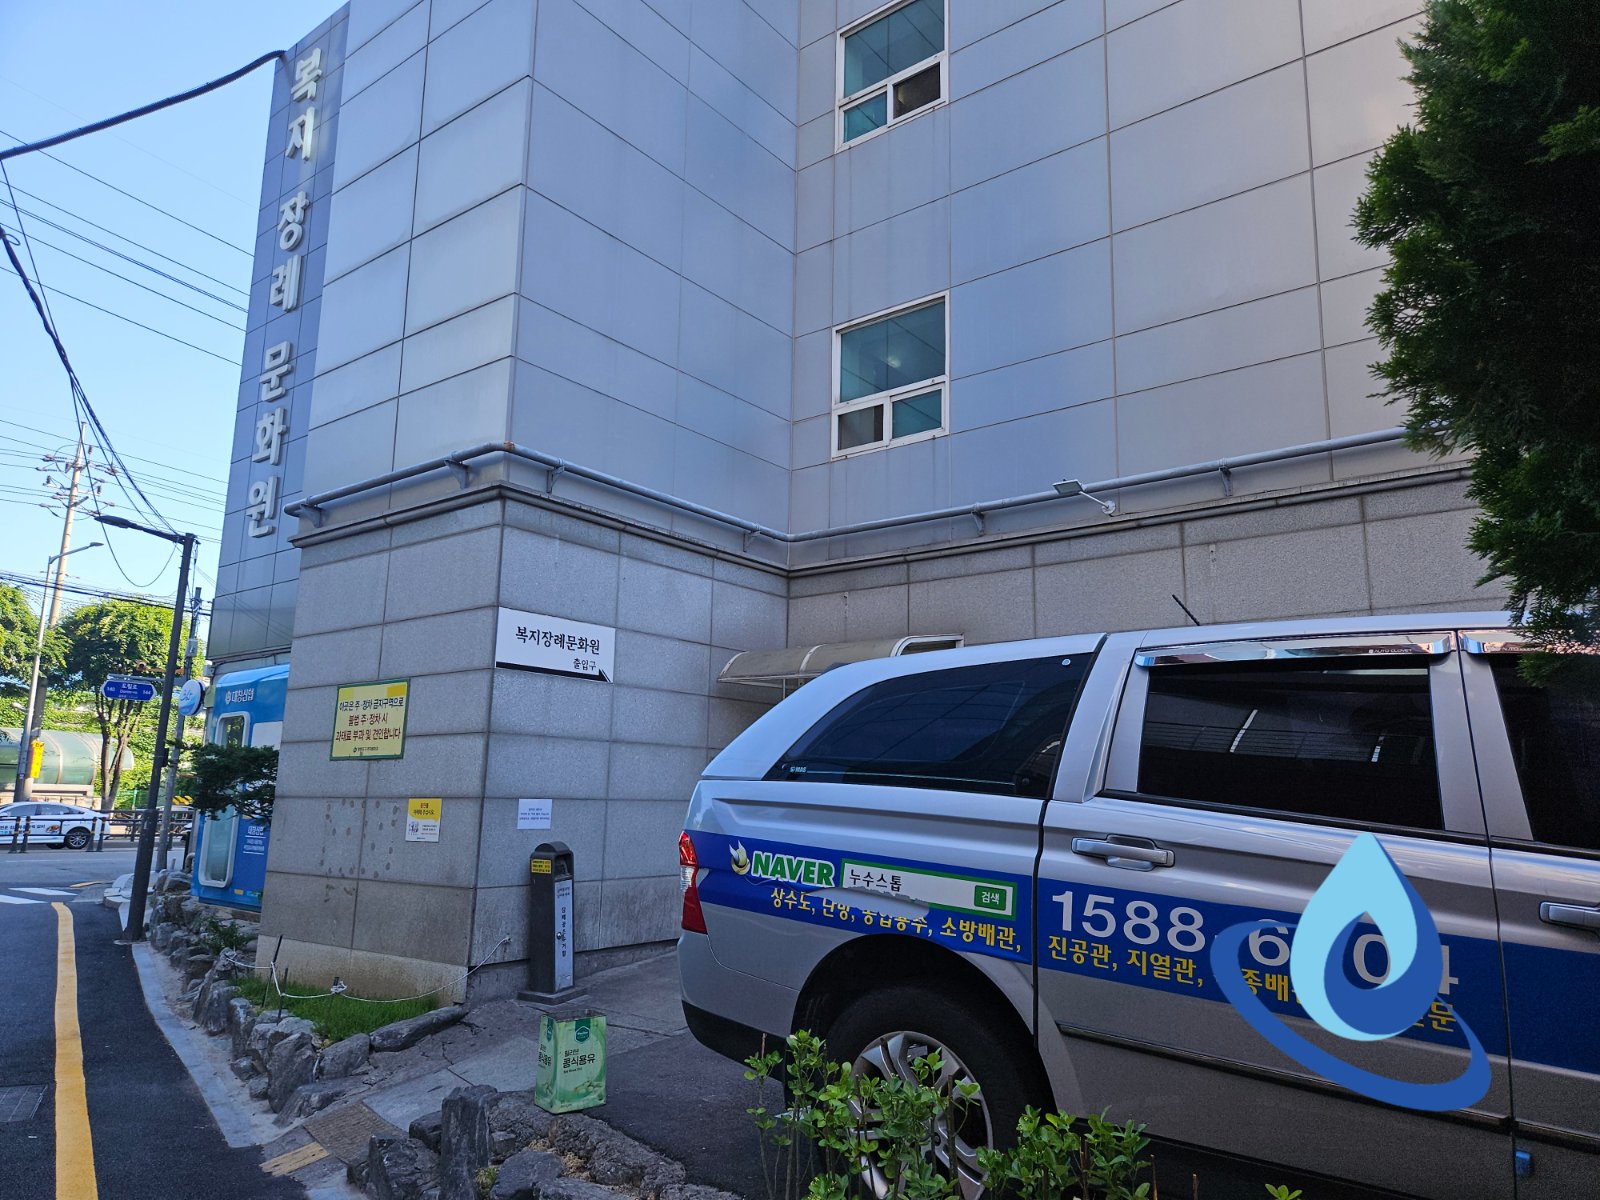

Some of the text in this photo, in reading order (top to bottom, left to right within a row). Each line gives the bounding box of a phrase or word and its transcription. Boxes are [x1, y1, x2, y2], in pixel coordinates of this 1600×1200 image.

[248, 47, 323, 538] 복지 장례 문화원
[515, 626, 600, 655] 복지장례문화원
[573, 658, 597, 671] 출입구
[348, 714, 359, 727] 불법
[751, 851, 835, 888] NAVER
[850, 869, 902, 892] 누수스톱
[981, 891, 1000, 905] 검색
[940, 917, 1021, 953] 소방배관,
[1048, 936, 1118, 972] 진공관,
[1127, 949, 1203, 987] 지열관,
